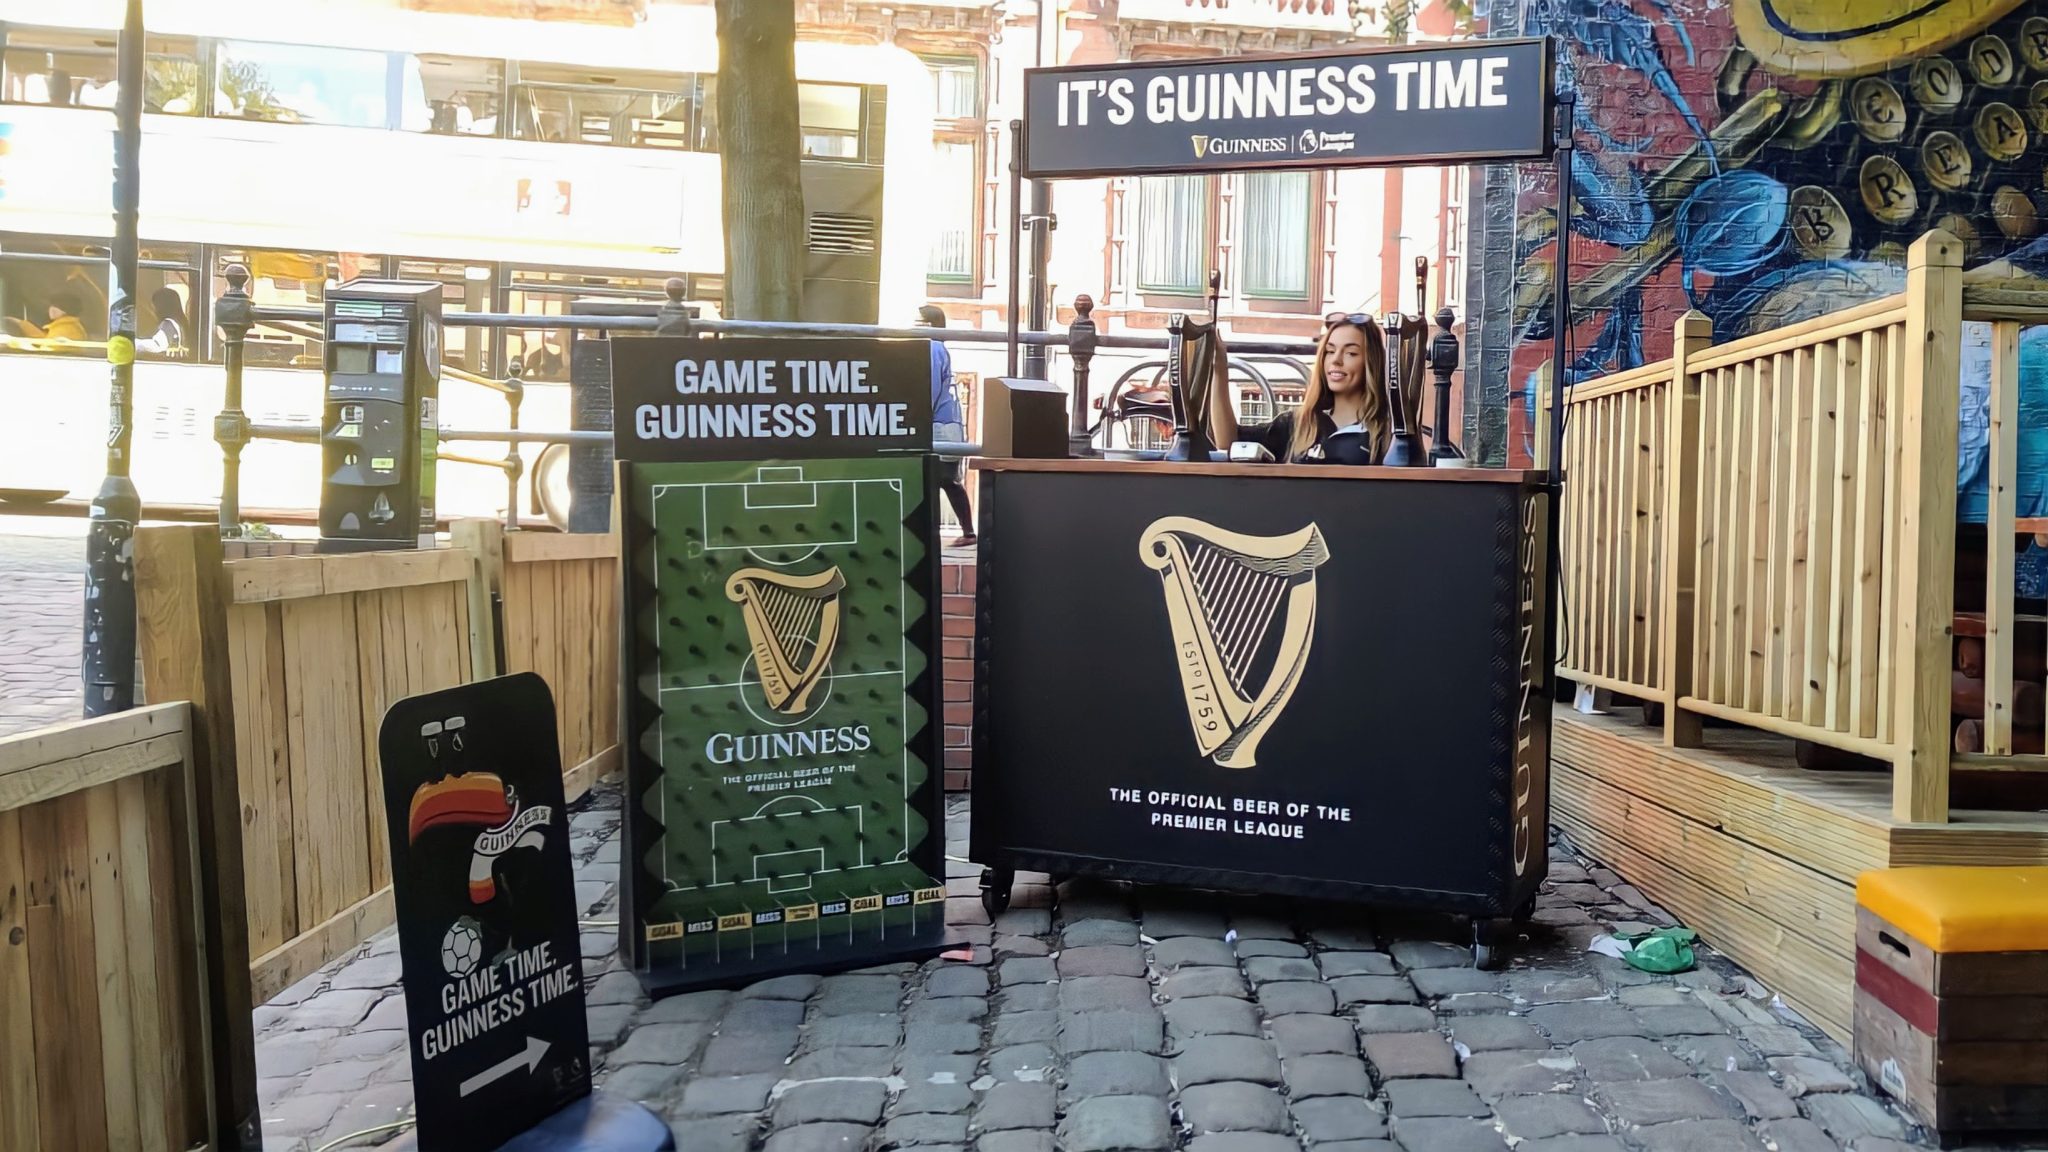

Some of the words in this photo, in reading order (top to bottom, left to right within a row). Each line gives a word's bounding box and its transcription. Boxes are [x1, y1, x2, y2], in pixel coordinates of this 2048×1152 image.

[1057, 77, 1135, 127] IT'S
[1147, 66, 1376, 124] GUINNESS
[1388, 57, 1509, 111] TIME
[1210, 137, 1287, 155] GUINNESS
[674, 359, 777, 394] GAME
[785, 360, 879, 394] TIME.
[635, 403, 817, 439] GUINNESS
[825, 403, 916, 436] TIME.
[1513, 495, 1538, 878] GUINNESS
[1191, 684, 1218, 731] 1759
[705, 725, 871, 764] GUINNESS
[1109, 787, 1141, 803] THE
[1148, 791, 1226, 811] OFFICIAL
[1233, 798, 1280, 815] BEER
[1286, 803, 1310, 817] OF
[1317, 805, 1351, 822] THE
[480, 808, 548, 851] GUINNESS
[1151, 812, 1227, 832] PREMIER
[1234, 820, 1304, 839] LEAGUE
[441, 965, 502, 1014] GAME
[505, 941, 557, 985] TIME.
[422, 987, 525, 1060] GUINNESS
[528, 963, 579, 1008] TIME.
